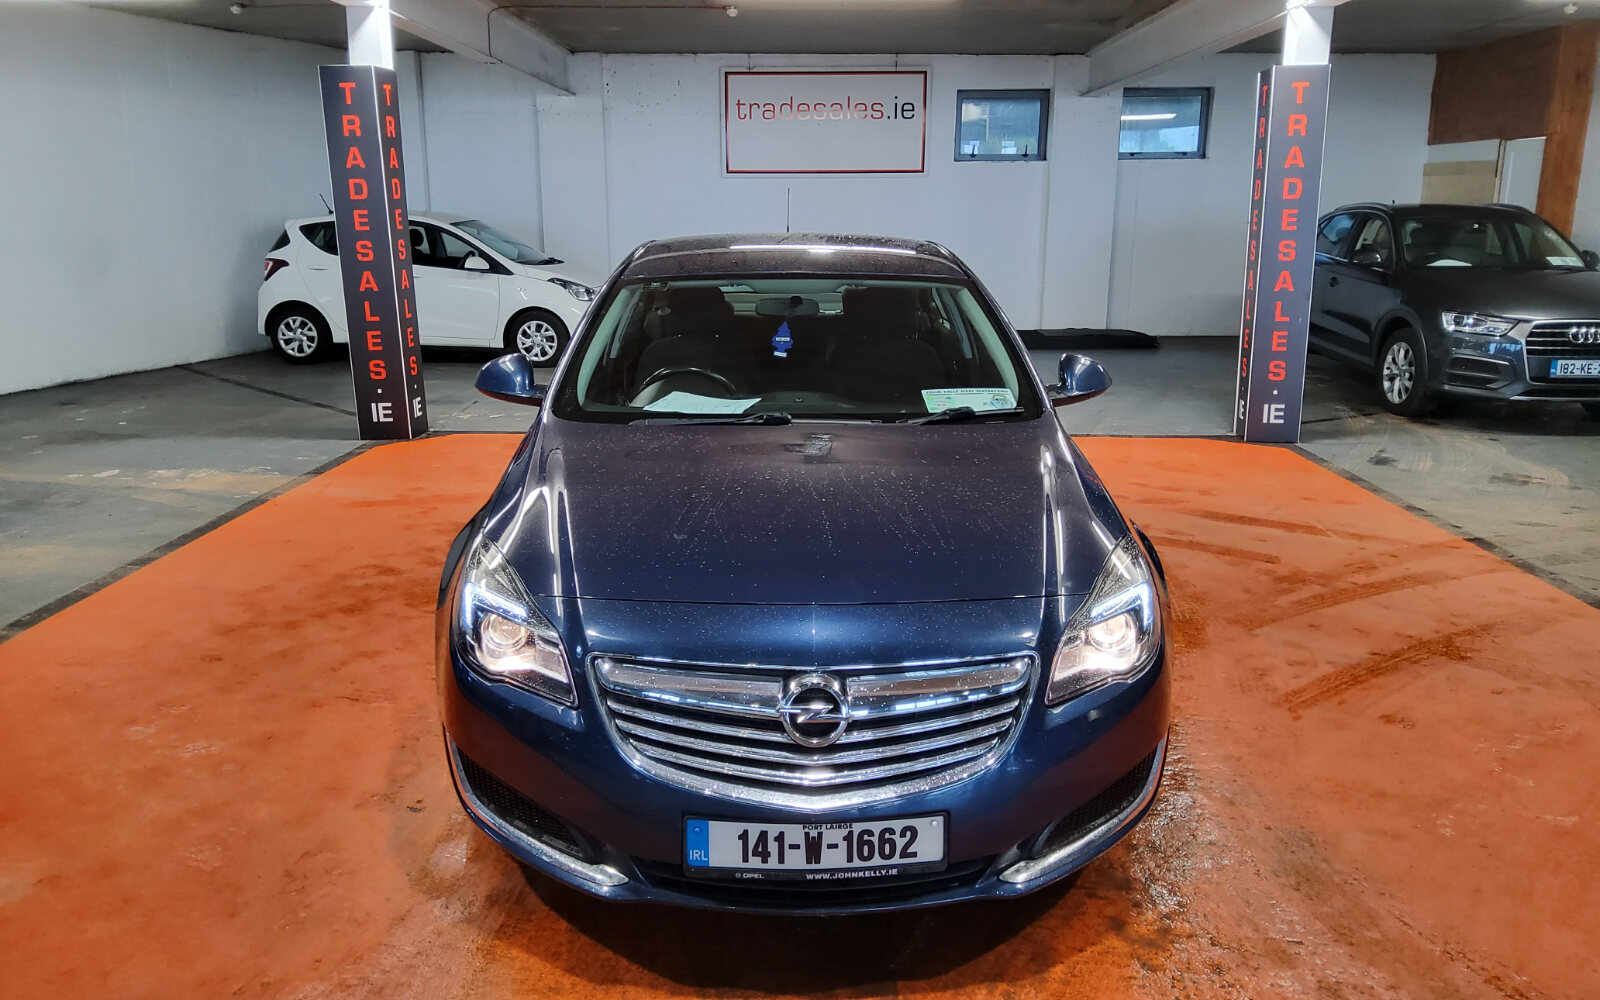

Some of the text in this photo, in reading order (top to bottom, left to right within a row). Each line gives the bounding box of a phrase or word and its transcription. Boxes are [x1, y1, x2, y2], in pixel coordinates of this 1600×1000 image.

[736, 96, 915, 121] tradesales.ie
[737, 825, 918, 865] 141-W-1662
[689, 849, 709, 861] IRL
[806, 868, 898, 880] WWW.JOHNKELLY.IE
